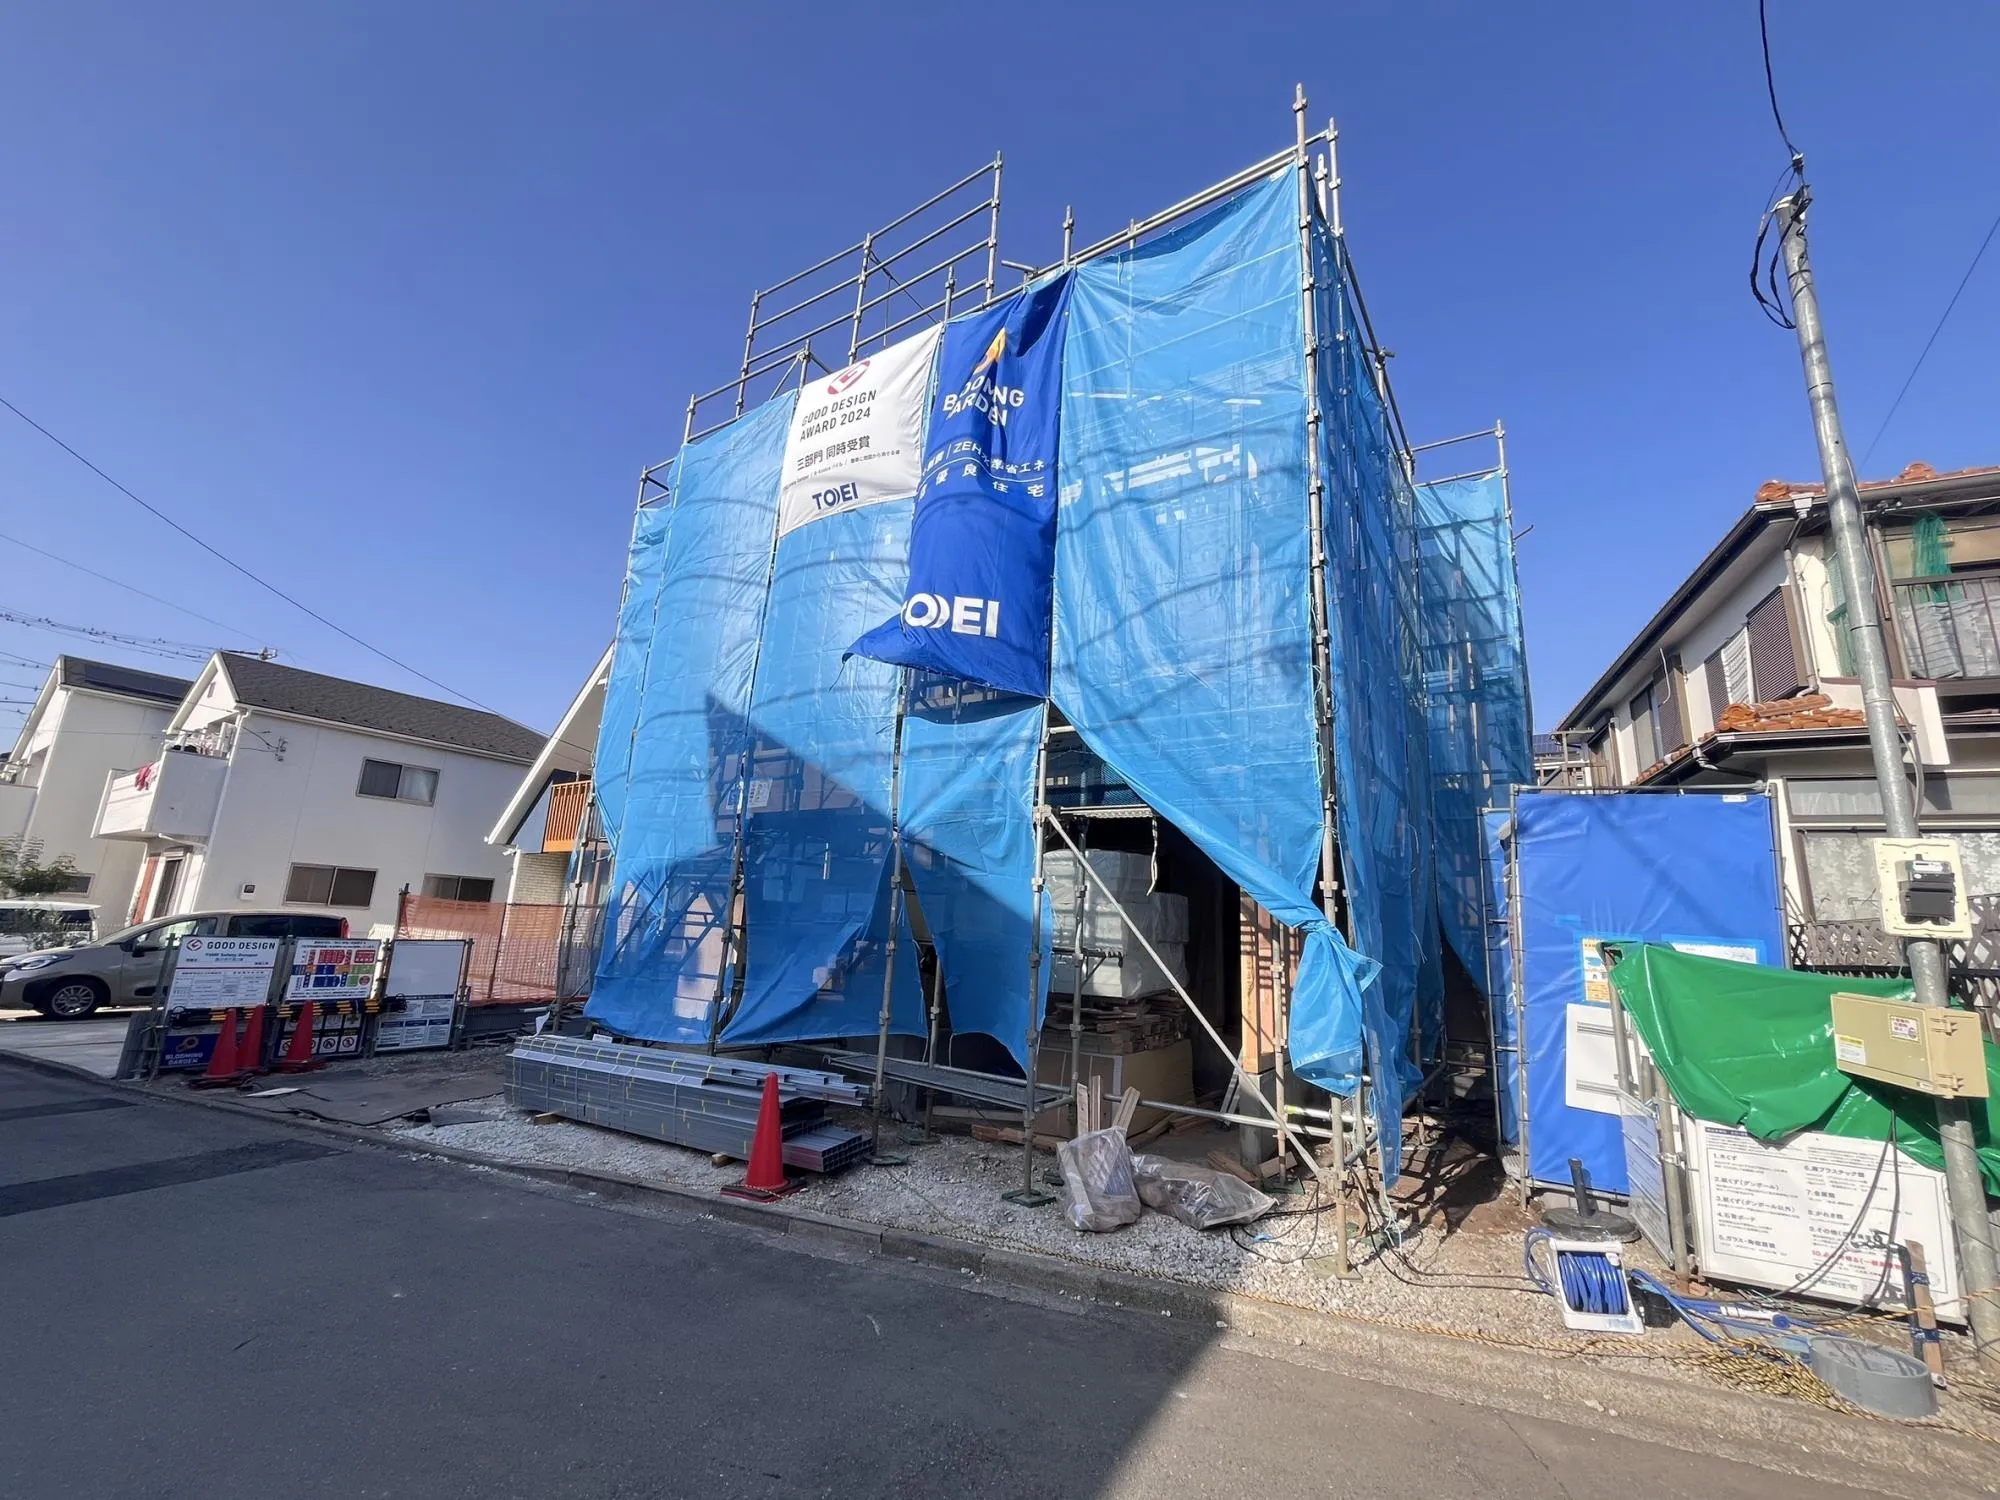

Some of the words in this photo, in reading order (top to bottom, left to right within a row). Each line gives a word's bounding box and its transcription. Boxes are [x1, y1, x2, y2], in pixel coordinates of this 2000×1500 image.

[799, 416, 836, 443] AWARD
[840, 405, 871, 426] 2024
[801, 405, 828, 427] GOOD
[831, 389, 876, 414] DESIGN
[796, 449, 823, 472] 三部門
[825, 434, 870, 460] 同時受賞
[811, 481, 859, 510] TOEI
[206, 941, 236, 951] GOOD
[238, 941, 276, 951] DESIGN
